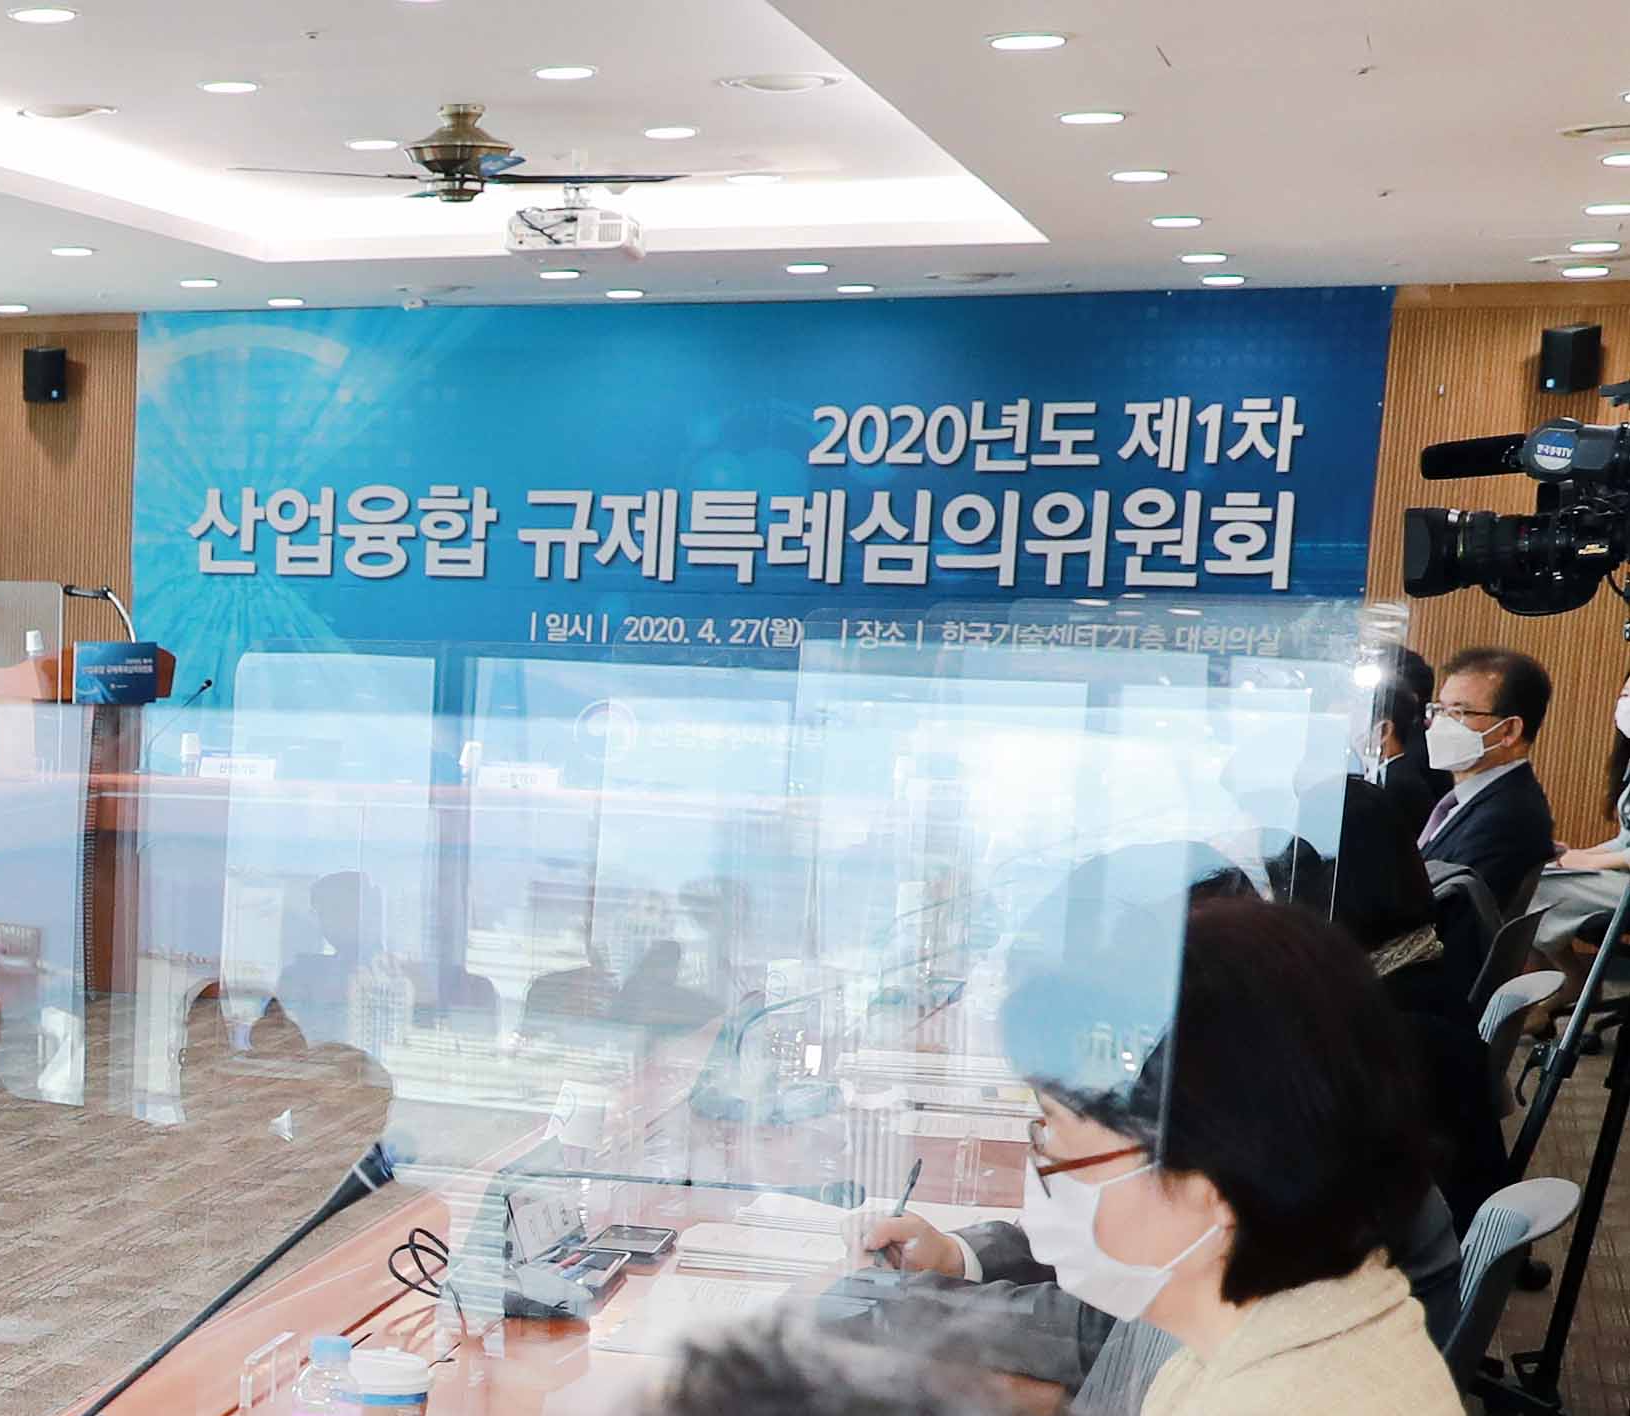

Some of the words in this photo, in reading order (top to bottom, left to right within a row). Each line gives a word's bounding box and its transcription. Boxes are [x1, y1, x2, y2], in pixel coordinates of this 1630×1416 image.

[807, 403, 1101, 473] 2020년도
[1118, 396, 1303, 474] 제1차
[188, 486, 497, 579] 산업융합
[517, 488, 1294, 590] 규제특례심의위원회
[545, 613, 593, 642] 일시
[624, 617, 690, 645] 2020.
[697, 618, 721, 645] 4.
[729, 617, 804, 648] 27(월)
[856, 620, 906, 650] 장소
[942, 622, 1098, 653] 한국기술센터
